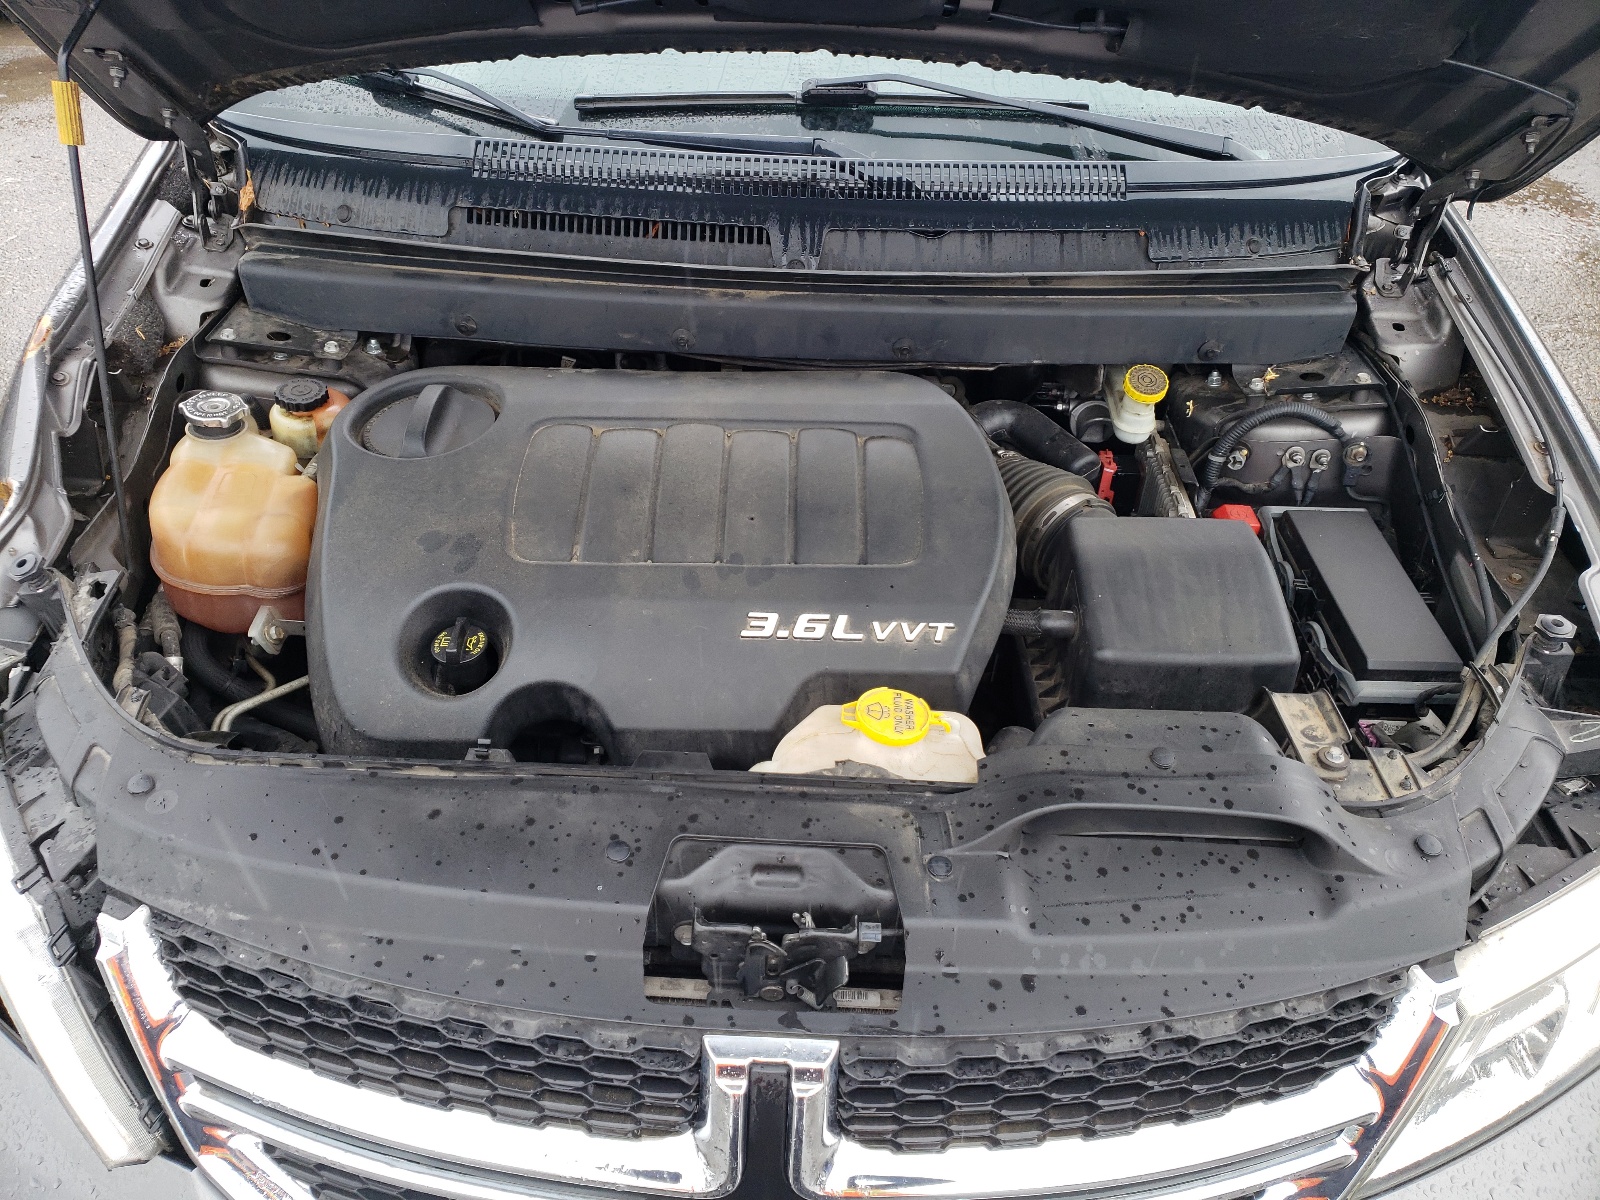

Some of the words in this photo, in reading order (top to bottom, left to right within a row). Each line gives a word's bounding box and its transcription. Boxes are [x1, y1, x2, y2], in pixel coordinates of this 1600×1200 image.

[740, 611, 865, 641] 3.6L
[872, 621, 956, 644] VVT
[893, 692, 902, 713] FLUID
[904, 698, 914, 731] WASHER
[894, 715, 904, 735] ONLY
